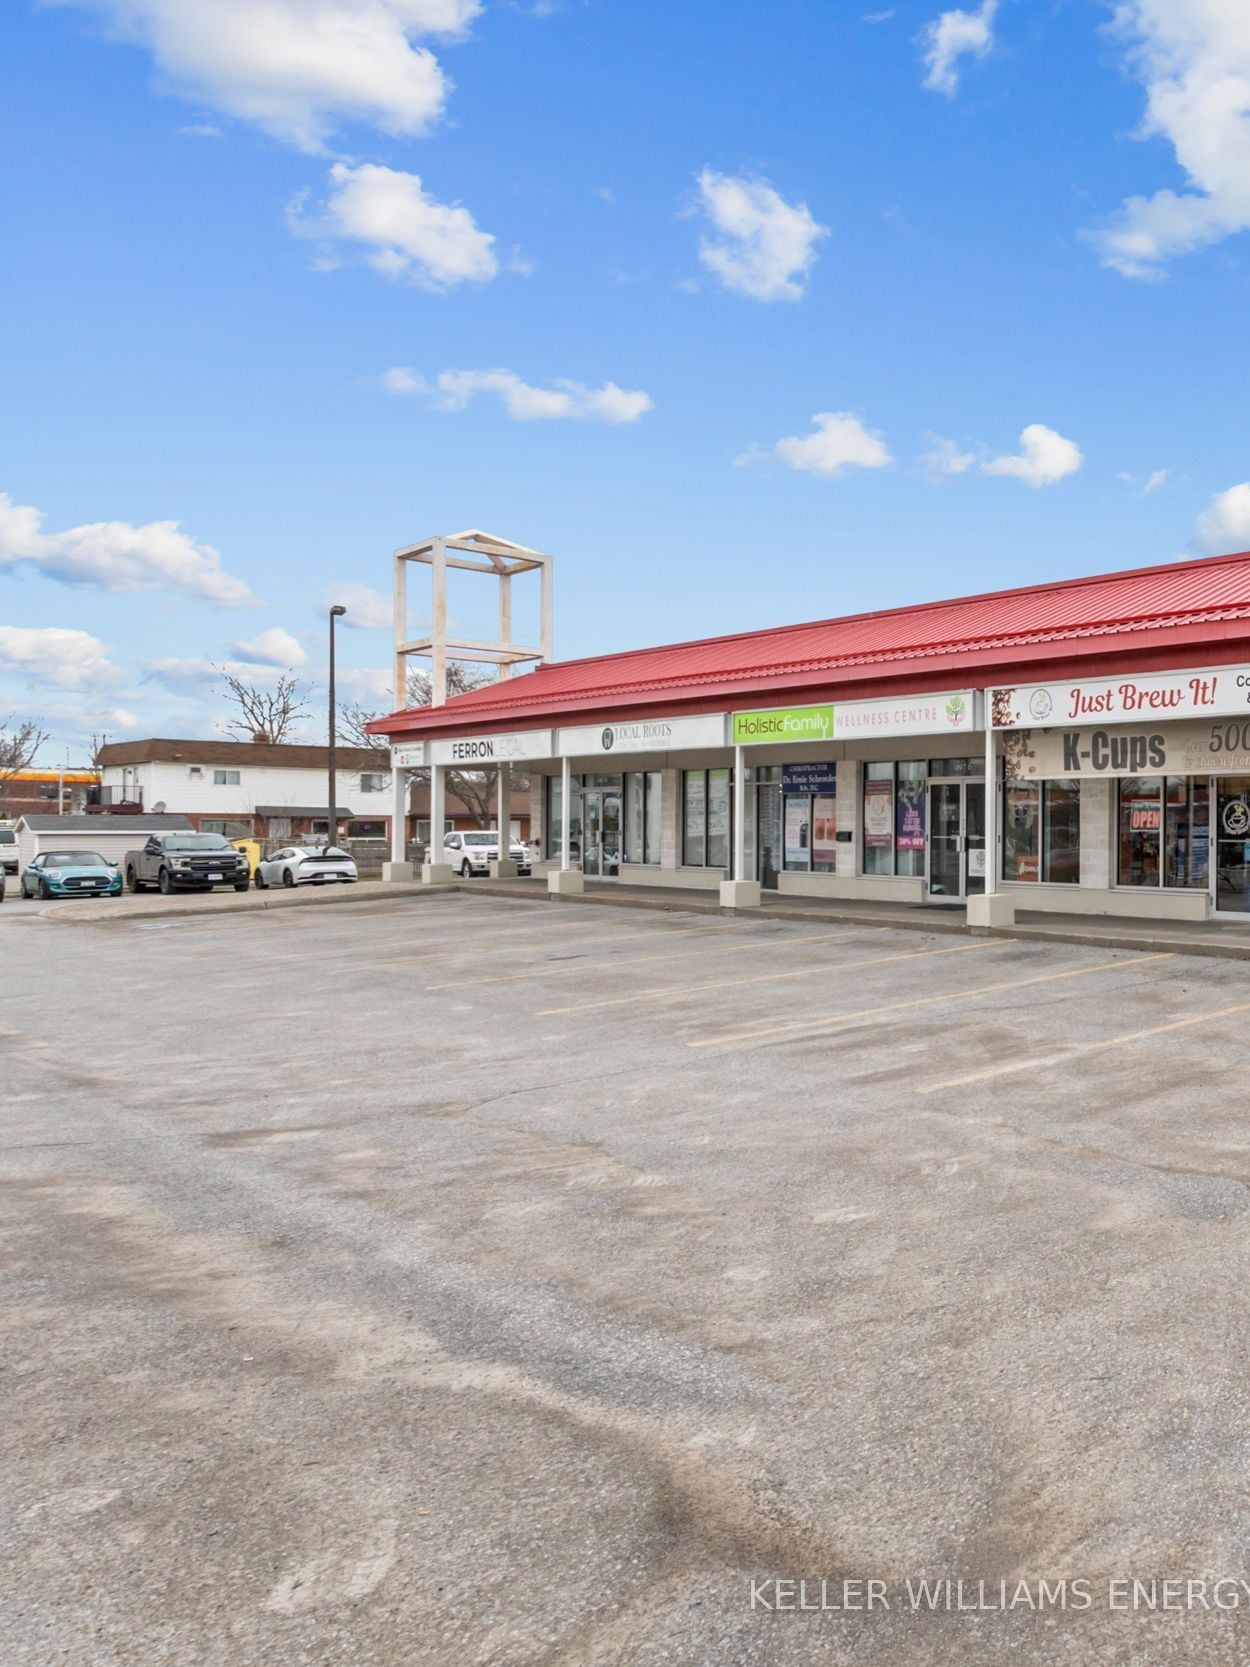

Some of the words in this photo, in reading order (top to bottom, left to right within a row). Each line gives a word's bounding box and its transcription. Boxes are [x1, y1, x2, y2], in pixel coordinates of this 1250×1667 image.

[1068, 688, 1115, 718] Just
[1118, 684, 1187, 711] Brew
[1188, 677, 1218, 706] It!
[835, 711, 889, 728] WELLNESS
[894, 708, 937, 723] CENTRE
[615, 726, 641, 740] LOCAL
[643, 722, 672, 738] ROOTS
[452, 741, 494, 760] FERRON
[1063, 730, 1166, 772] K-Cups
[1132, 811, 1160, 828] OPEN
